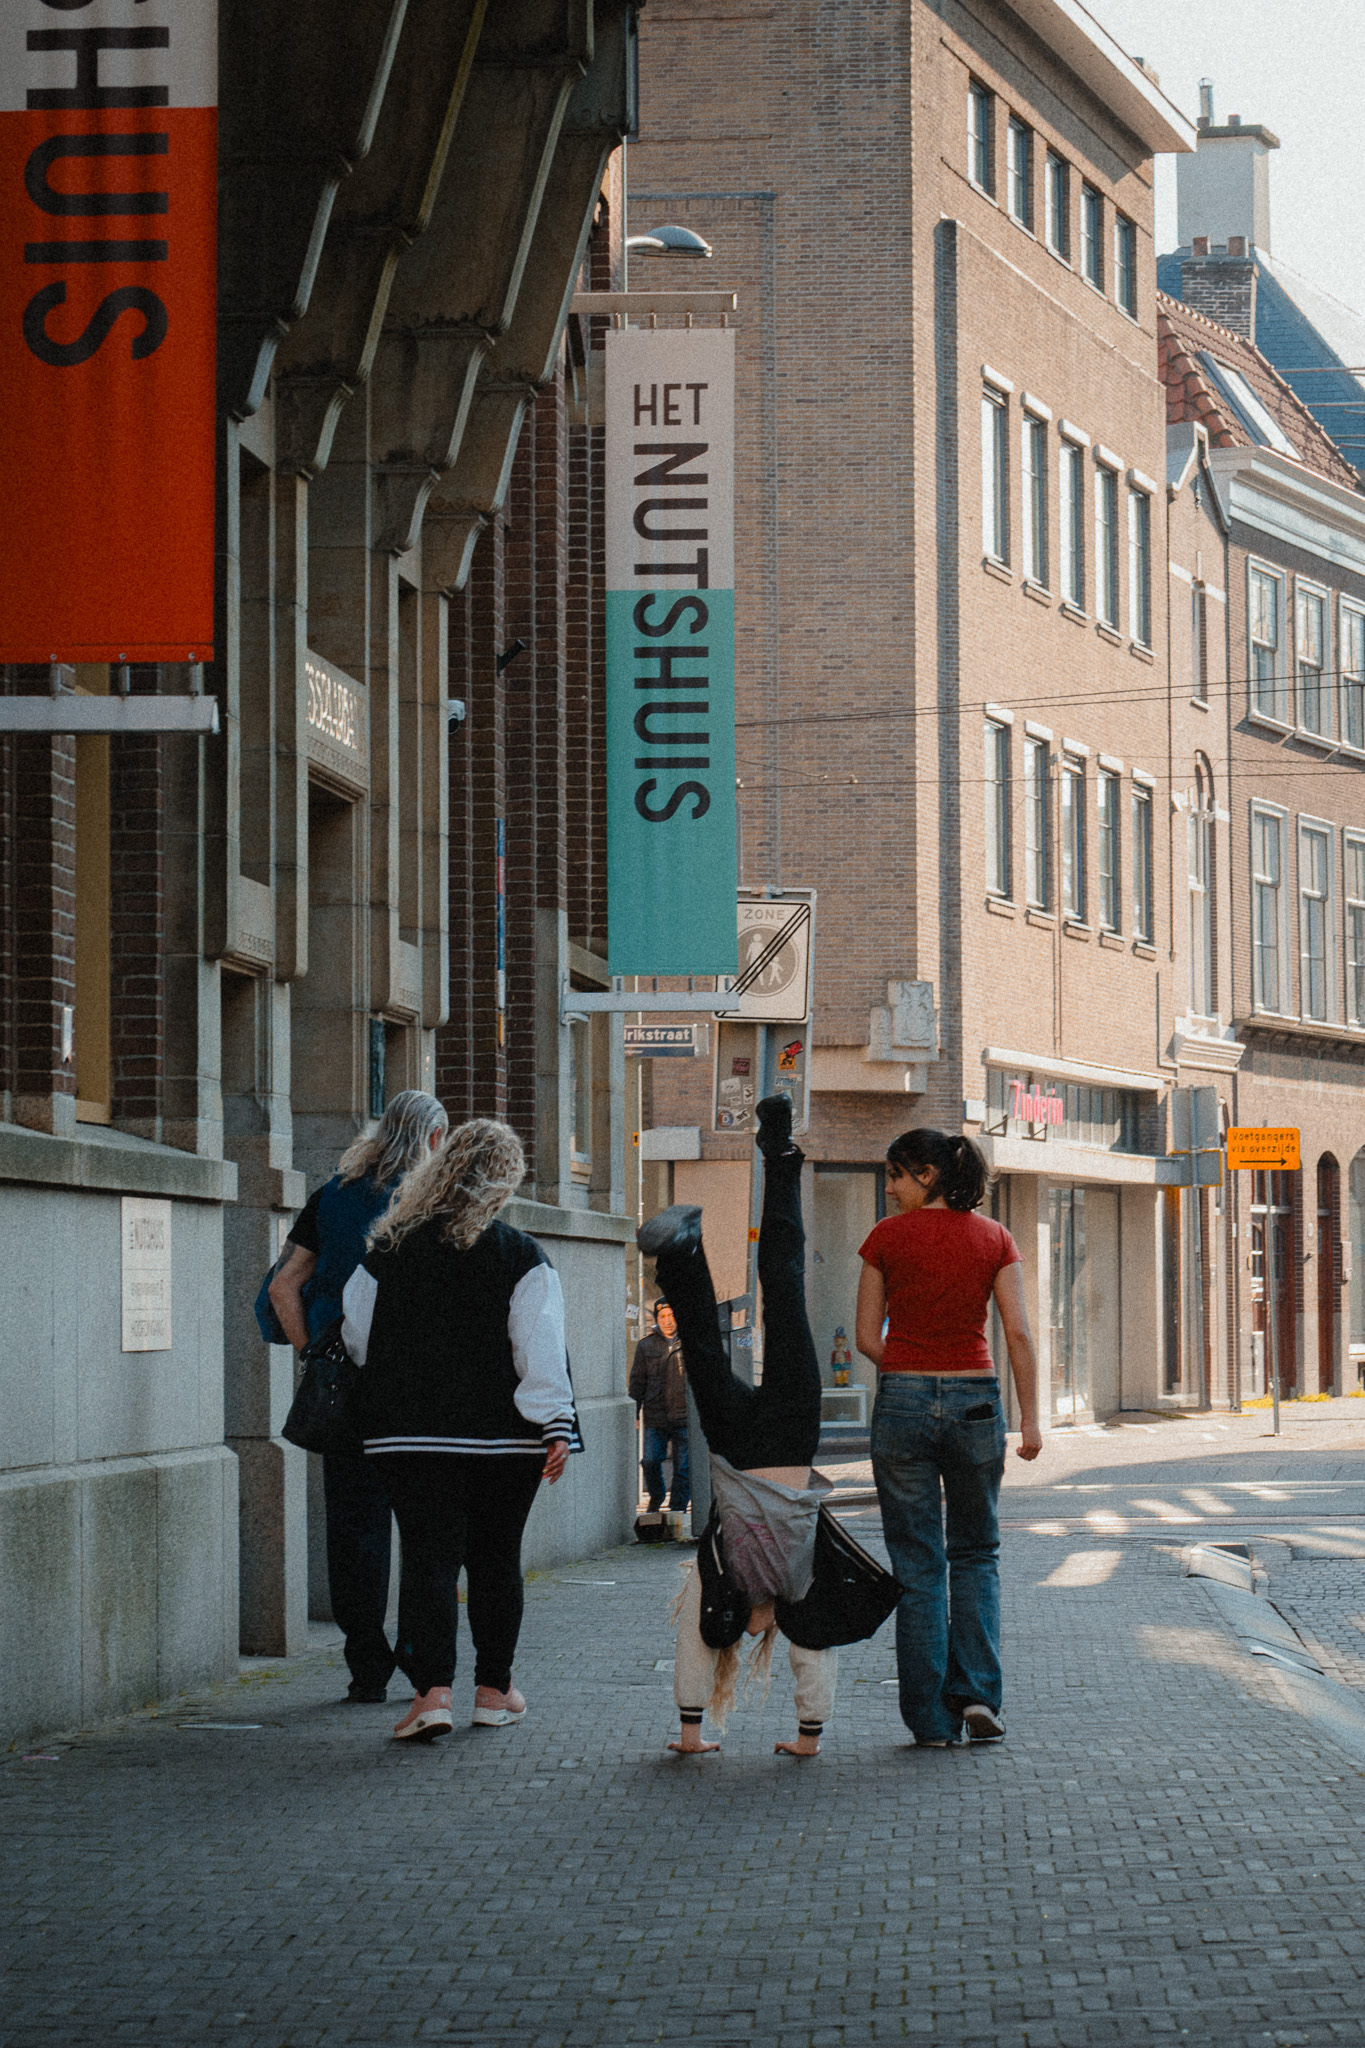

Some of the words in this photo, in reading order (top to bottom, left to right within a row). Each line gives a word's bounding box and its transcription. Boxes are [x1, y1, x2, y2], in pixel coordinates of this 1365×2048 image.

[22, 0, 169, 367] HUIS
[634, 383, 708, 427] HET
[633, 443, 711, 822] NUTSHUIS
[744, 908, 785, 920] ZONE
[1232, 1132, 1295, 1143] Voetgangers
[1232, 1145, 1245, 1153] via
[1249, 1144, 1296, 1155] overzijde
